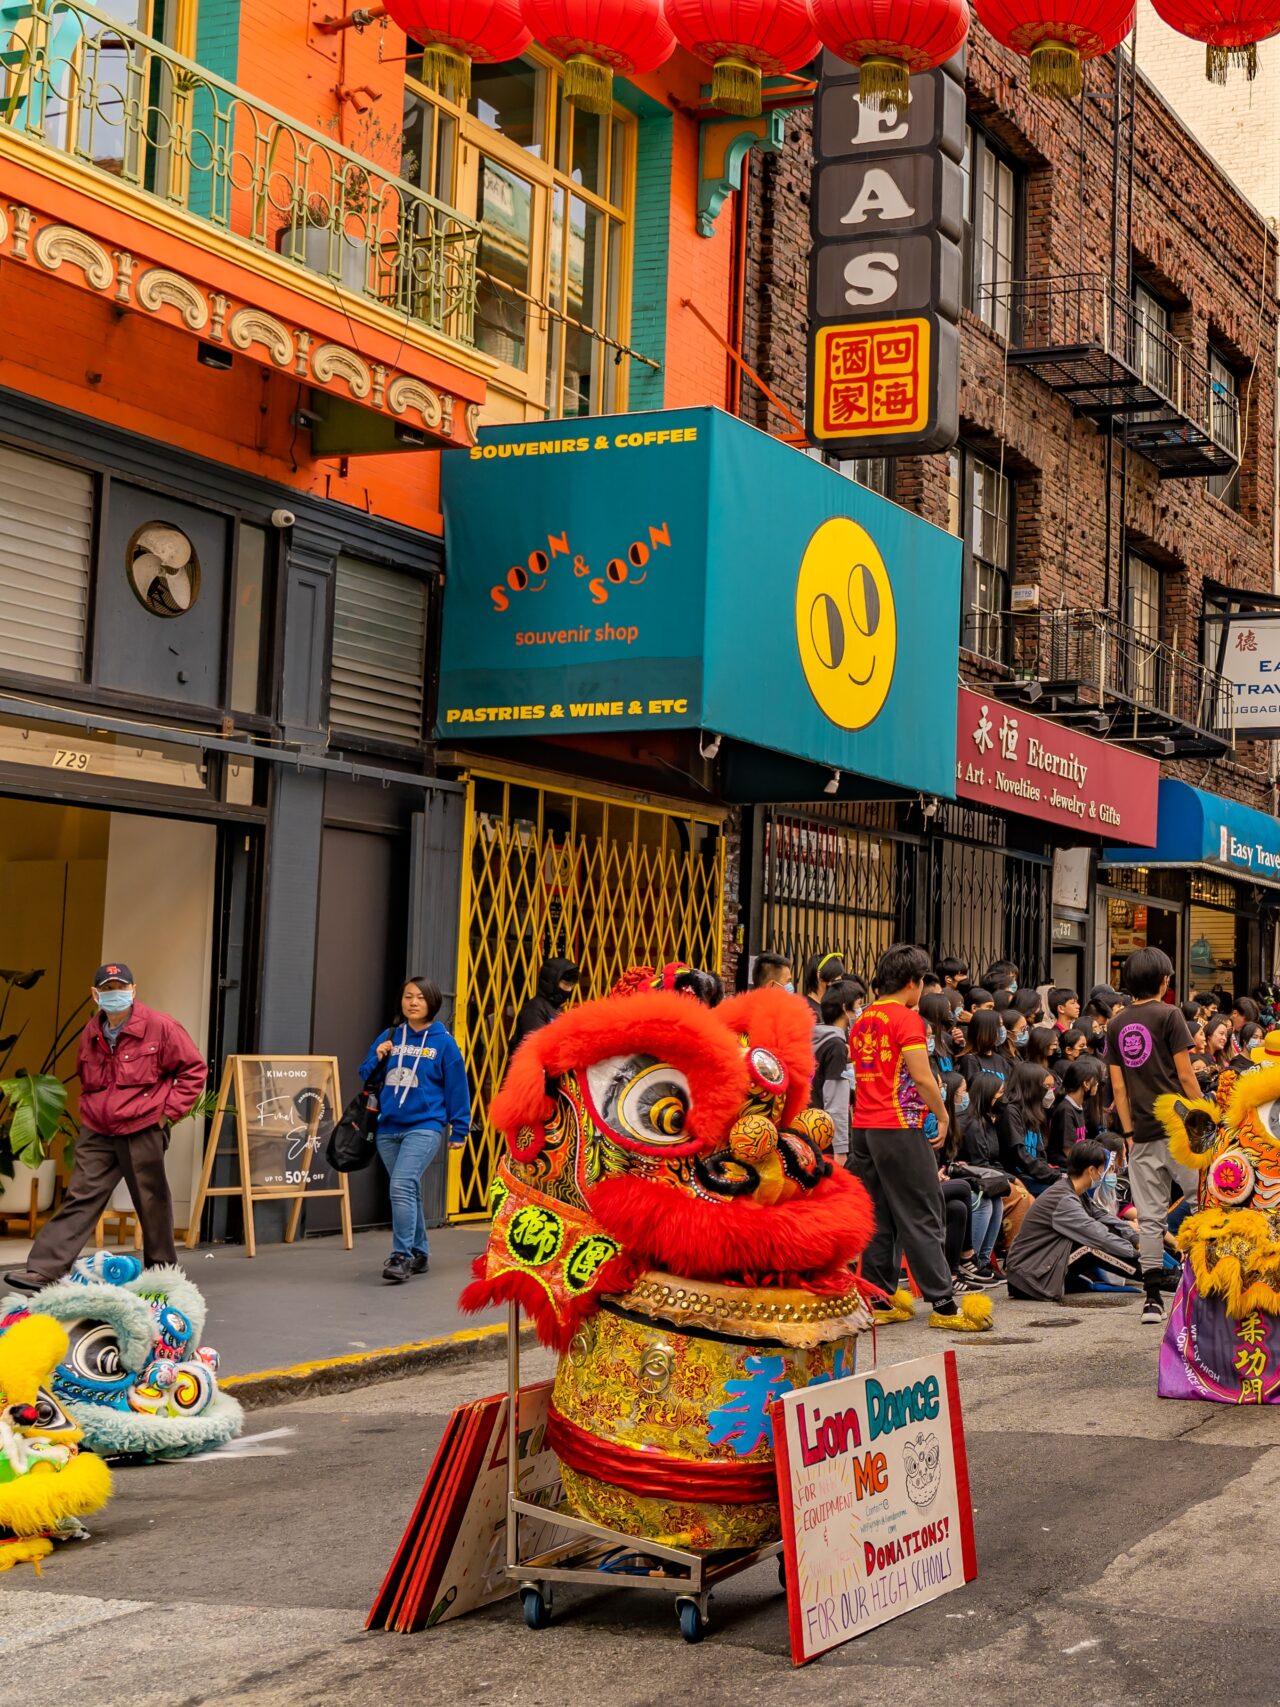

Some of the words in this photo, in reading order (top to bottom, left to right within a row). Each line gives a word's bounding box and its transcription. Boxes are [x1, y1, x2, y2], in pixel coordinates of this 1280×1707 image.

[469, 438, 590, 461] SOUVENIRS
[594, 434, 610, 450] &
[614, 426, 699, 448] COFFEE
[573, 555, 590, 577] &
[515, 625, 590, 647] souvenir
[594, 621, 639, 646] shop
[1235, 629, 1258, 651] 德
[446, 704, 545, 724] PASTRIES
[550, 703, 566, 718] &
[569, 701, 624, 719] WINE
[627, 700, 644, 715] &
[647, 698, 688, 715] ETC
[54, 751, 88, 769] 729
[1027, 737, 1088, 789] Eternity
[965, 763, 985, 785] Art
[995, 770, 1041, 801] Novelties
[1050, 788, 1087, 818] Jewelry
[1088, 801, 1097, 818] &
[1099, 803, 1121, 826] Gifts
[1230, 836, 1254, 866] Easy
[1060, 922, 1071, 936] 737
[266, 1070, 307, 1078] KIM+ONO
[255, 1095, 294, 1127] Final
[285, 1171, 311, 1184] 50%
[1177, 1326, 1189, 1352] LION
[1190, 1324, 1198, 1342] WE
[1193, 1345, 1202, 1362] FLY
[1234, 1312, 1266, 1404] 柔功門
[1199, 1363, 1221, 1382] HIGH
[796, 1403, 862, 1467] Lion
[865, 1375, 940, 1441] Dance
[852, 1451, 889, 1501] Me
[798, 1483, 816, 1506] FOR
[803, 1492, 854, 1531] EQUIPMENT
[864, 1516, 949, 1577] DONATIONS!
[806, 1597, 839, 1645] FOR
[841, 1585, 870, 1630] OUR
[871, 1567, 910, 1612] HIGH
[911, 1547, 953, 1594] SCHOOLS
